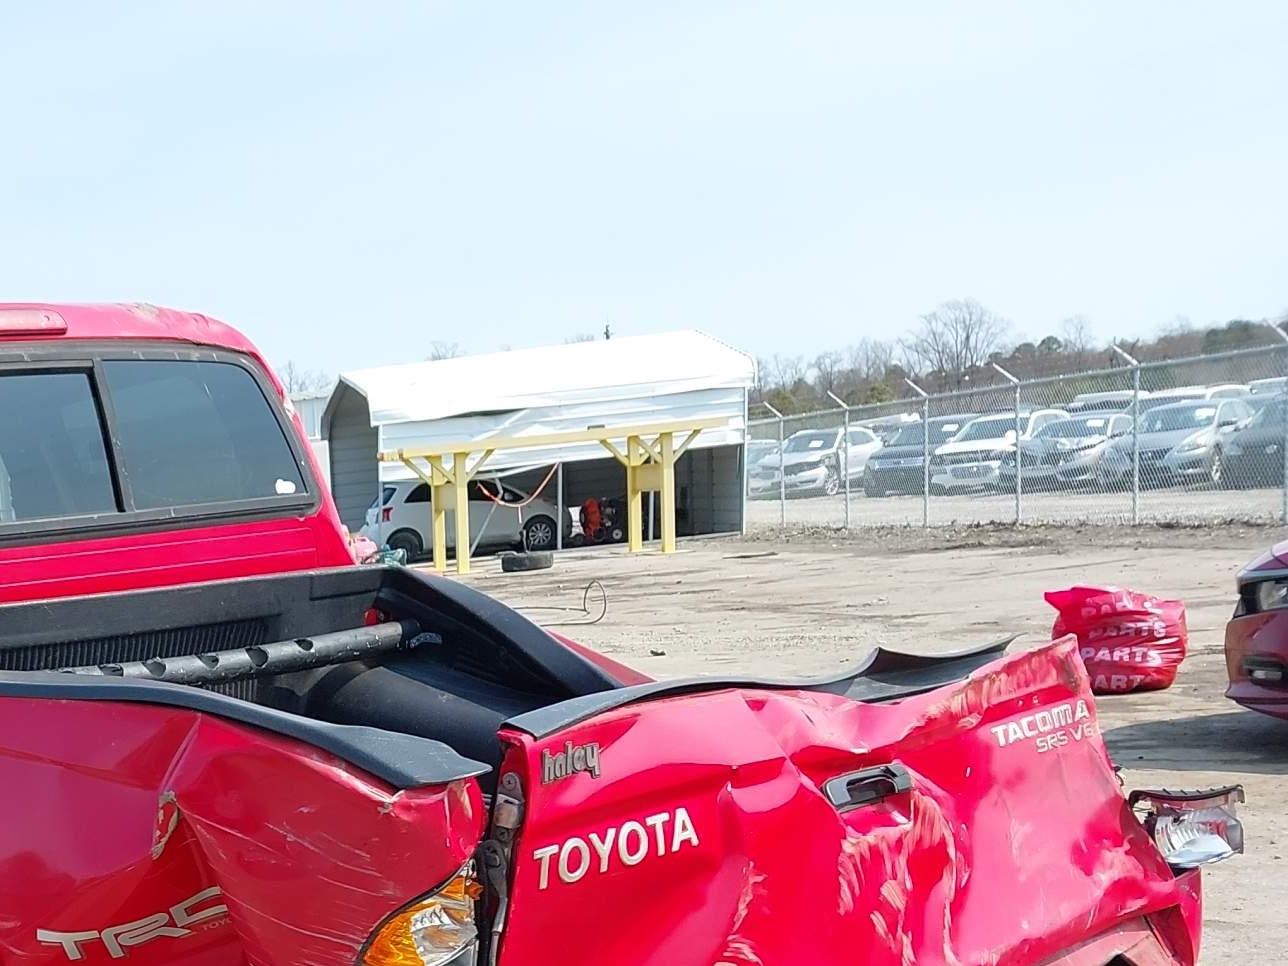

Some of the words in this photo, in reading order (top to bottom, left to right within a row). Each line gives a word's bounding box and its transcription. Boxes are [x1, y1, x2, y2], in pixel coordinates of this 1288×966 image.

[1080, 647, 1163, 667] PARTS
[991, 699, 1091, 748] TACOMA
[532, 807, 700, 891] TOYOTA
